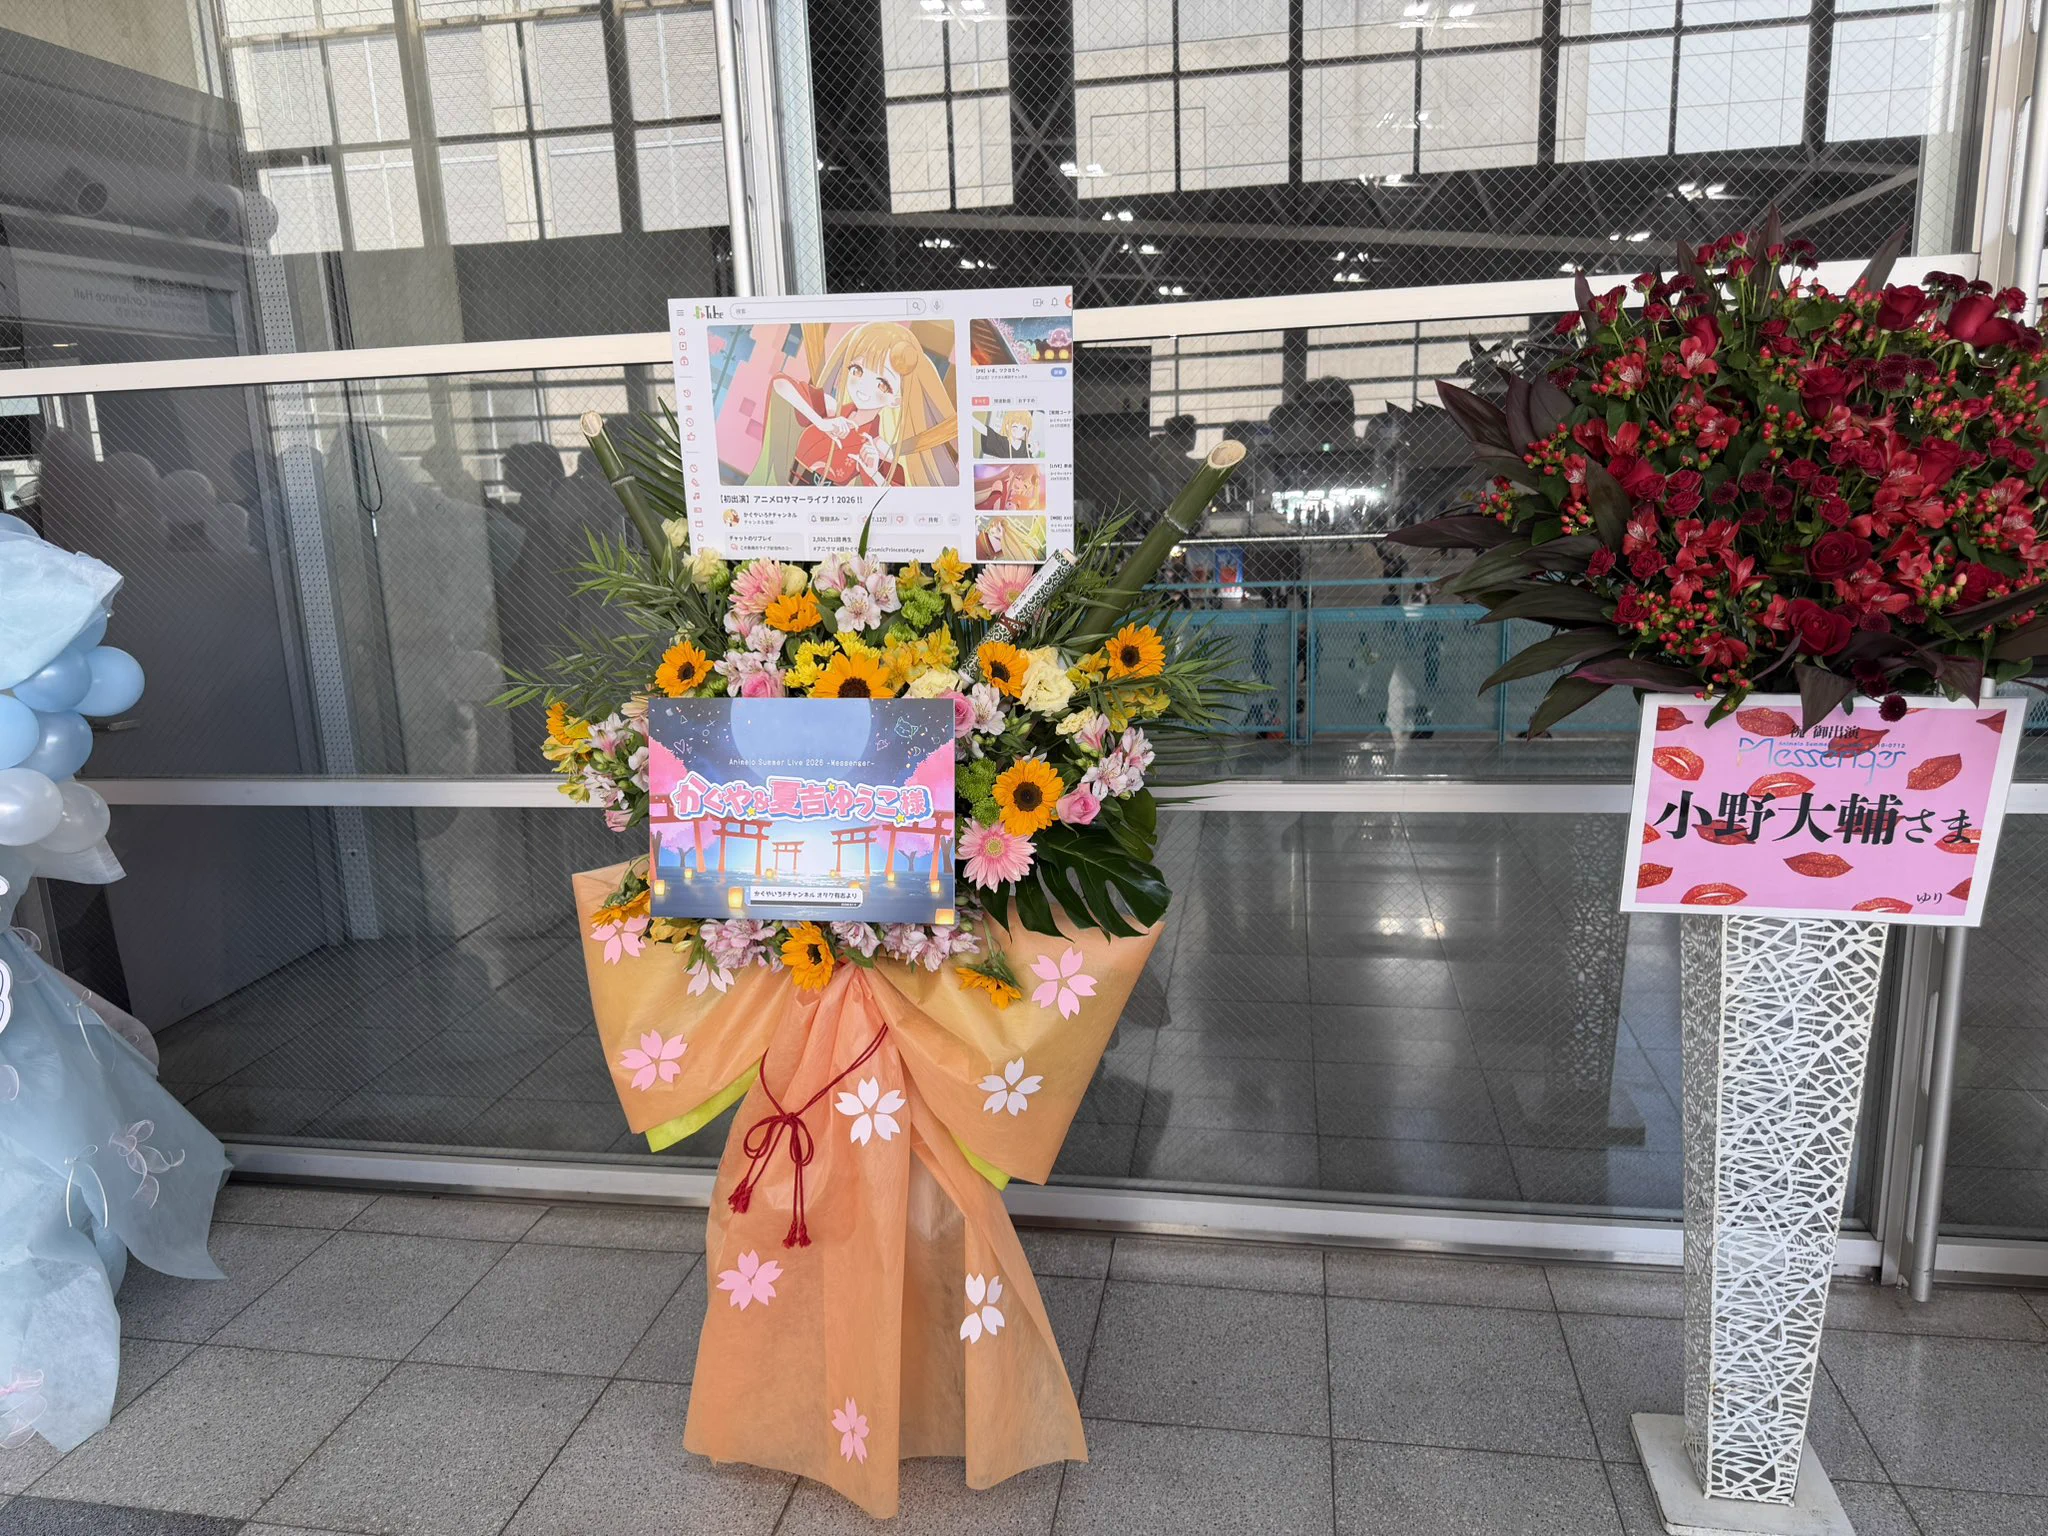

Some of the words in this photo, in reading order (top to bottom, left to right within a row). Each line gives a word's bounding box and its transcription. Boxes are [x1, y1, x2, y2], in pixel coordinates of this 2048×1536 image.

[866, 546, 925, 554] CosmicPrincessKaguya
[1812, 725, 1862, 740] 御出演
[1738, 737, 1907, 787] Messenger
[1652, 789, 1973, 846] 小野大輔さま
[1915, 892, 1944, 905] ゆり
